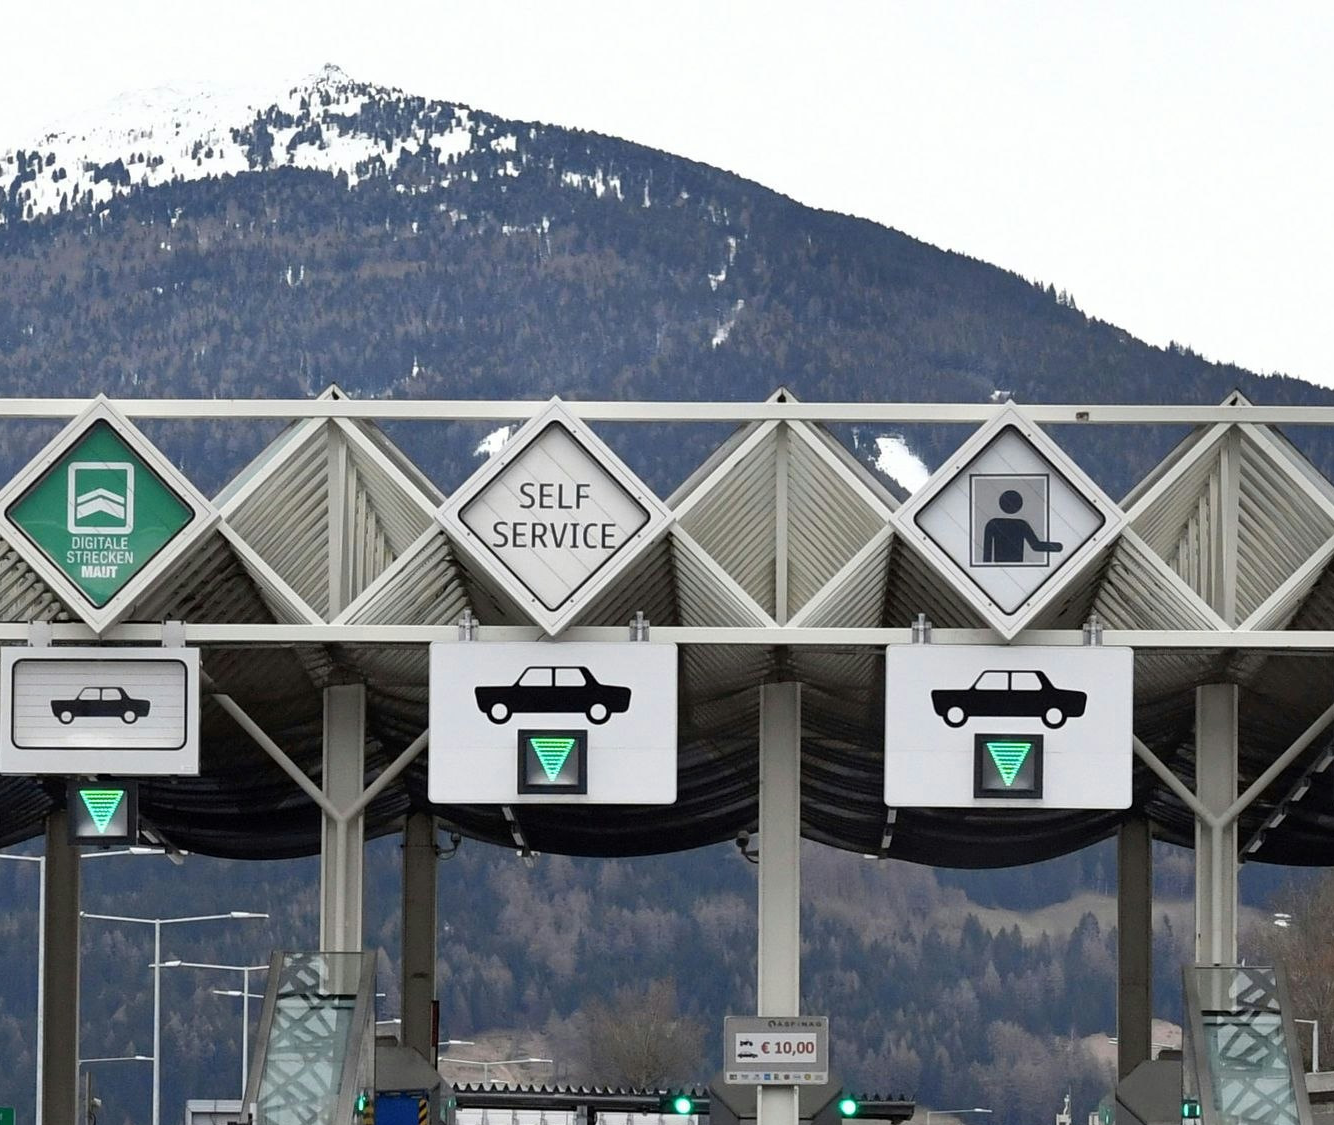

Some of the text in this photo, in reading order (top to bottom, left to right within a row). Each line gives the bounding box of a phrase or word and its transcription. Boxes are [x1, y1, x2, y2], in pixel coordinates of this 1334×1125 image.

[519, 482, 591, 510] SELF
[492, 521, 616, 550] SERVICE
[71, 536, 128, 550] DIGITALE
[67, 551, 134, 564] STRECKEN
[81, 565, 118, 578] MAUT
[761, 1041, 815, 1056] € 10,00
